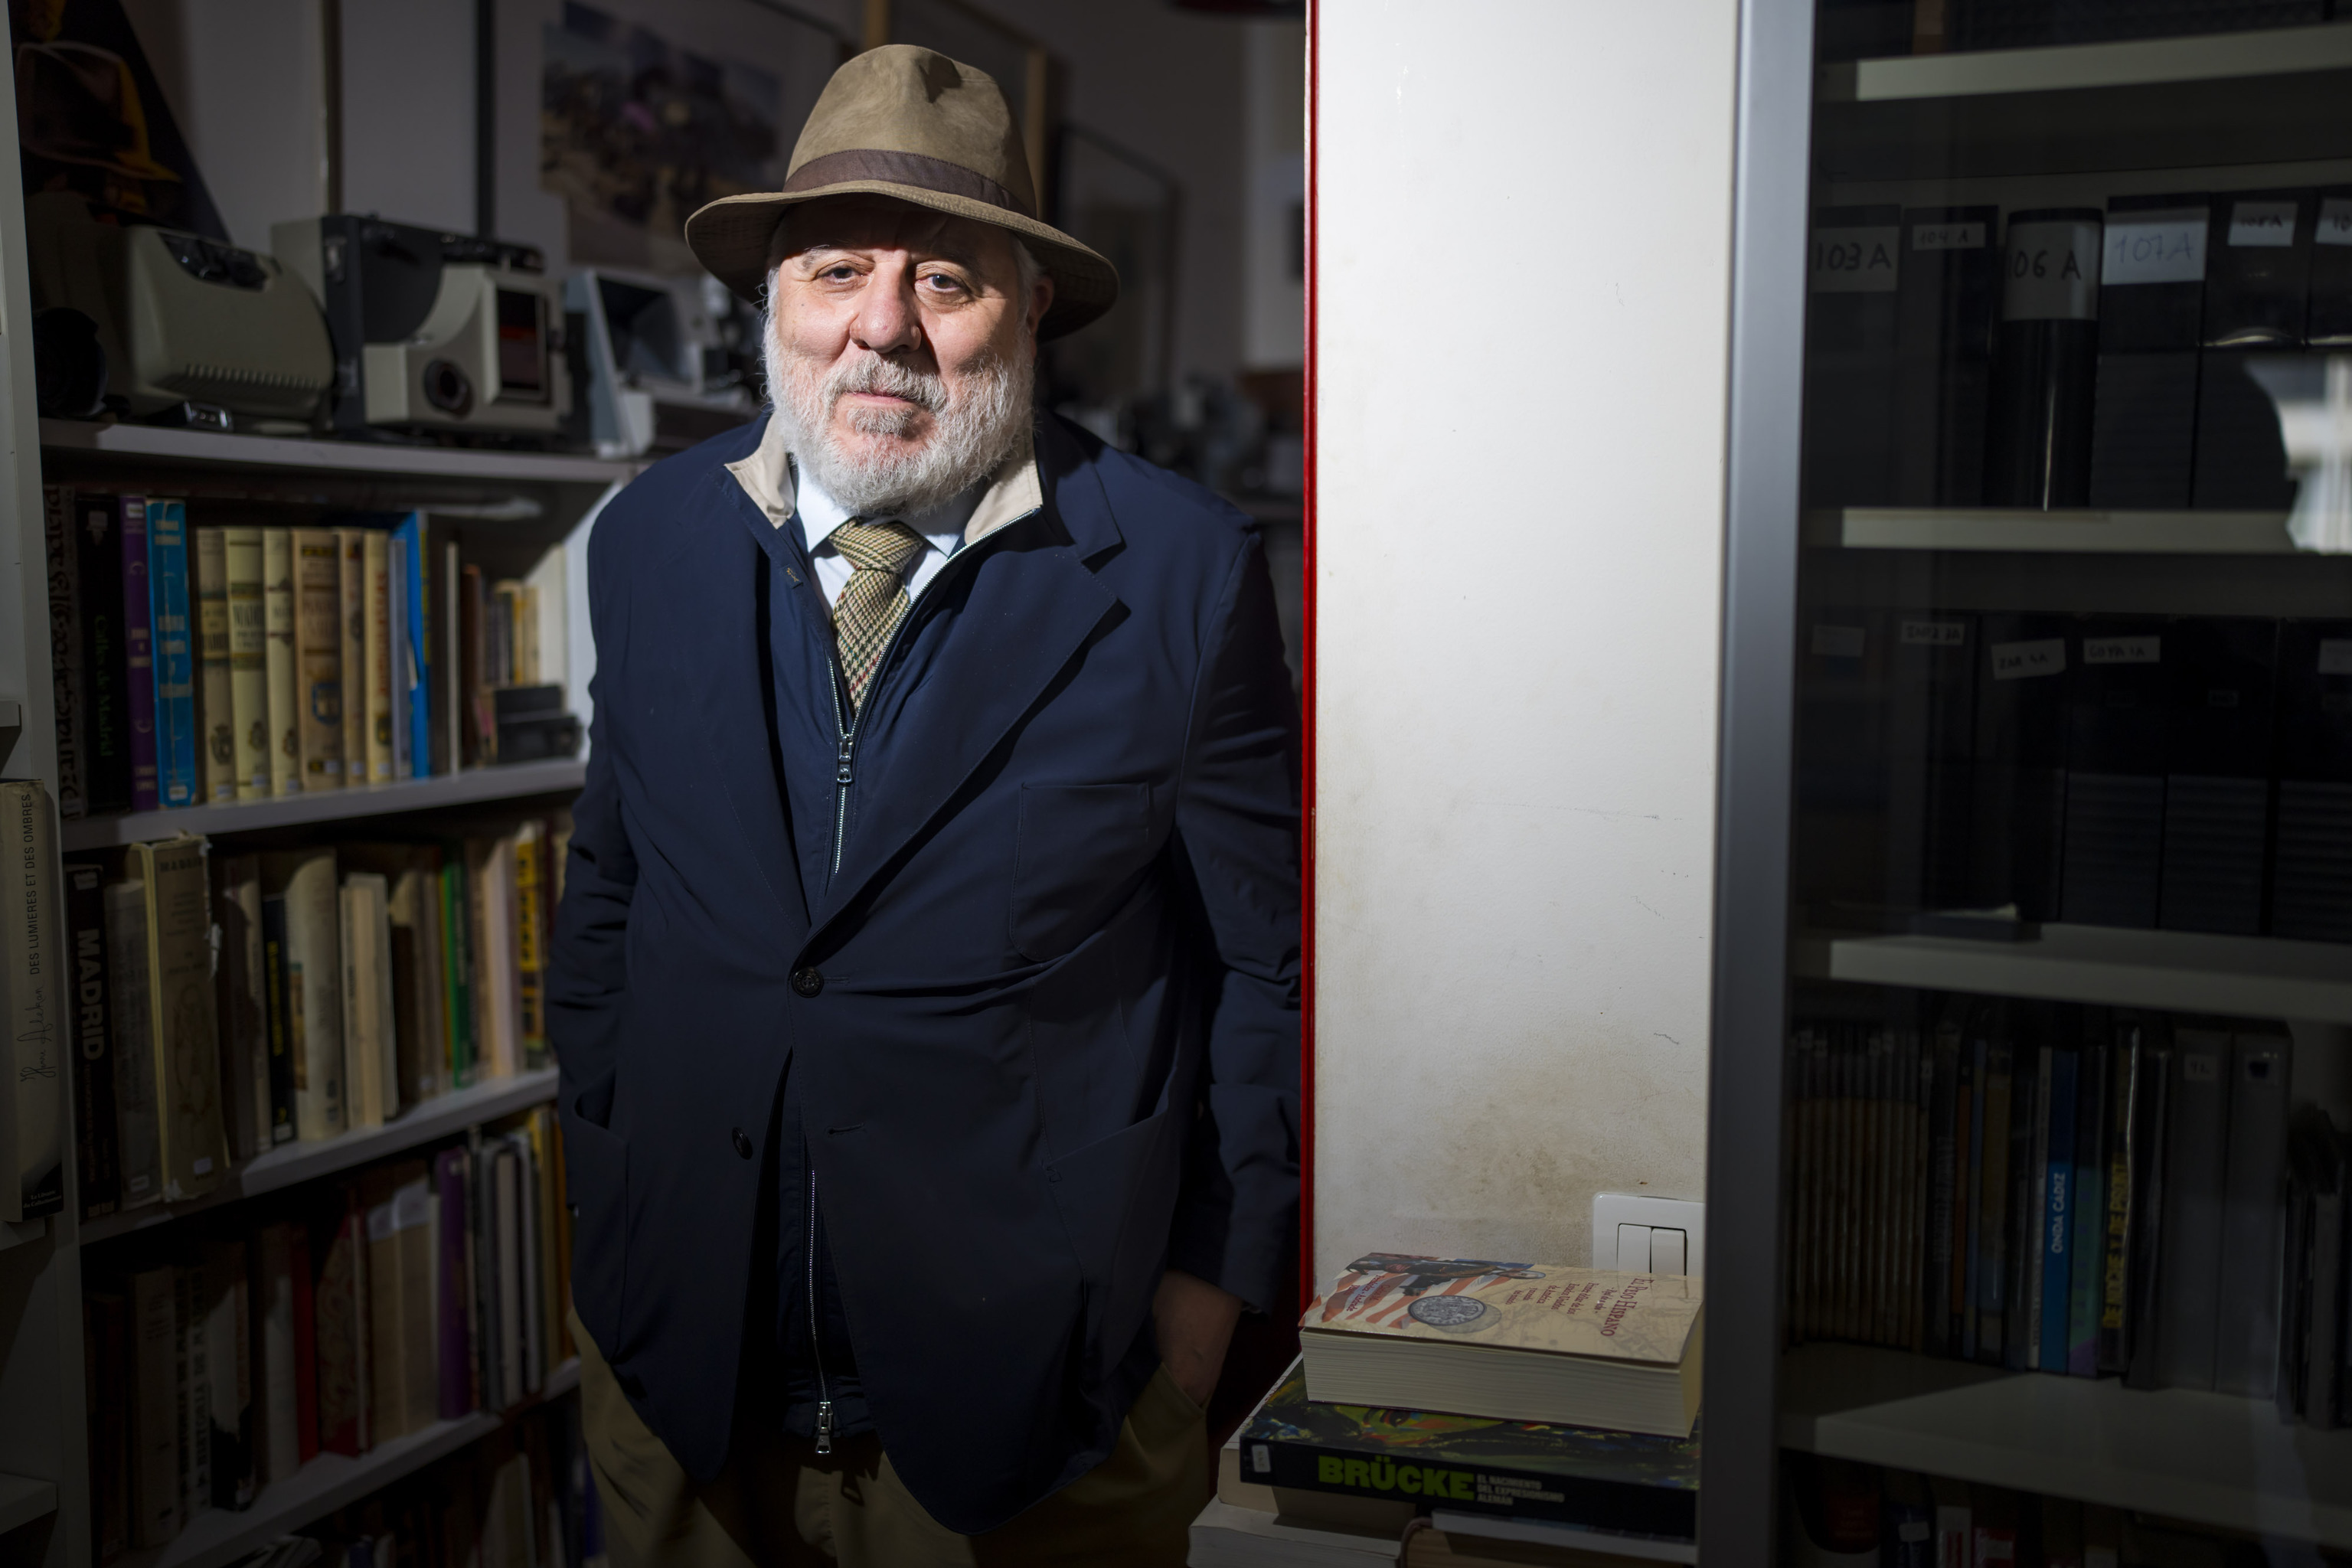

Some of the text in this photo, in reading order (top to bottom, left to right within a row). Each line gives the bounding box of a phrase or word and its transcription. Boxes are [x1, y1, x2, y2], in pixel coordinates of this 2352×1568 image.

[1958, 228, 1968, 243] A
[97, 694, 114, 757] Madrid
[21, 793, 34, 843] OMBRES
[24, 846, 35, 869] DES
[25, 873, 36, 887] ET
[27, 890, 39, 949] LUMIERES
[29, 952, 40, 975] DES
[76, 926, 106, 1061] MADRID
[2050, 1171, 2066, 1254] ONDA CÁDIZ
[2108, 1213, 2126, 1236] DE
[1581, 1282, 1599, 1293] Primer
[2104, 1253, 2125, 1305] NOCHE
[1536, 1289, 1557, 1304] América
[1550, 1282, 1580, 1310] Estados Unidos
[1620, 1285, 1648, 1299] PESO
[1600, 1300, 1638, 1336] HISPANO
[2102, 1307, 2123, 1329] DE
[1318, 1455, 1475, 1501] BRÜCKE
[1477, 1472, 1543, 1490] EL NACIMIENTO
[1477, 1483, 1566, 1503] DEL EXPRESIONISMO
